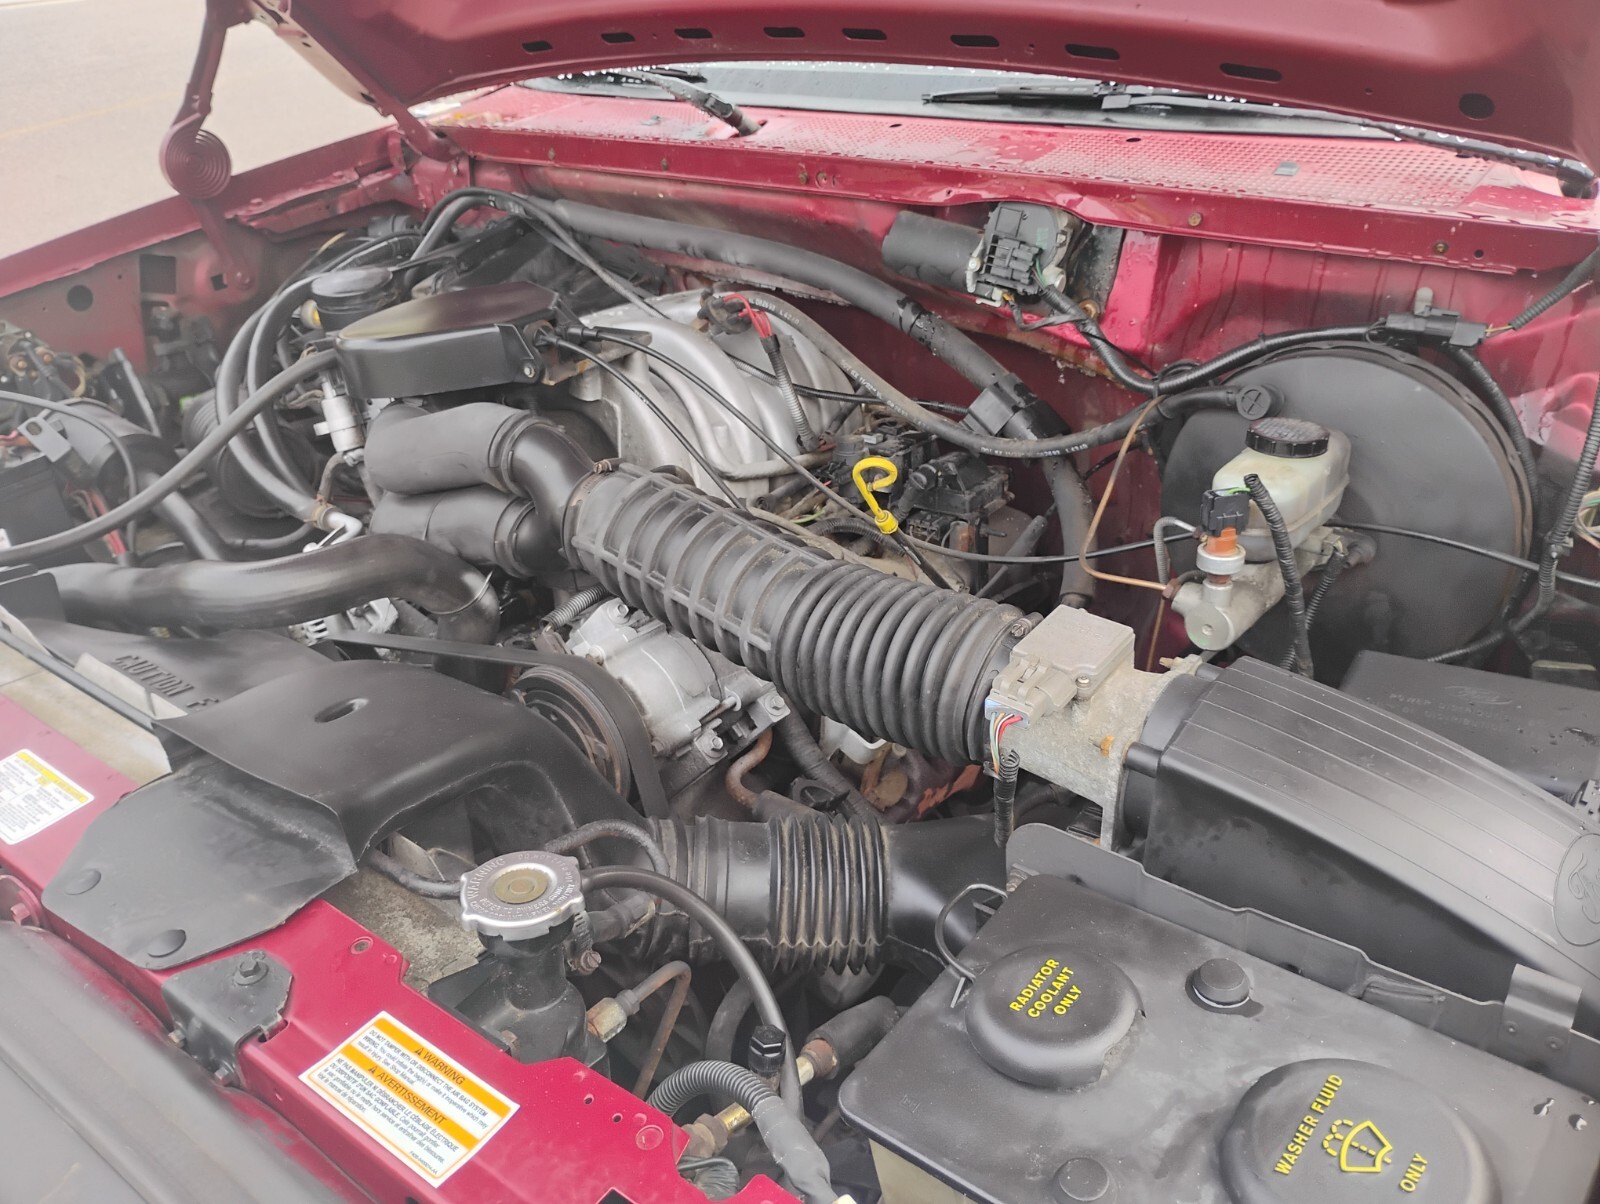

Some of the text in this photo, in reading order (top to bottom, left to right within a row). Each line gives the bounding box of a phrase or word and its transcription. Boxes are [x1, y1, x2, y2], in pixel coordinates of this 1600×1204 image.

[467, 858, 506, 899] WARNING
[1010, 958, 1060, 1012] RADIATOR
[1028, 966, 1074, 1018] COOLANT
[1054, 984, 1082, 1015] ONLY
[421, 1051, 466, 1085] WARNING
[375, 1070, 447, 1126] AVERTISSEMENT
[467, 1101, 488, 1117] SYSTEM
[1274, 1074, 1344, 1176] WASHER FLUID
[1399, 1152, 1428, 1192] ONLY
